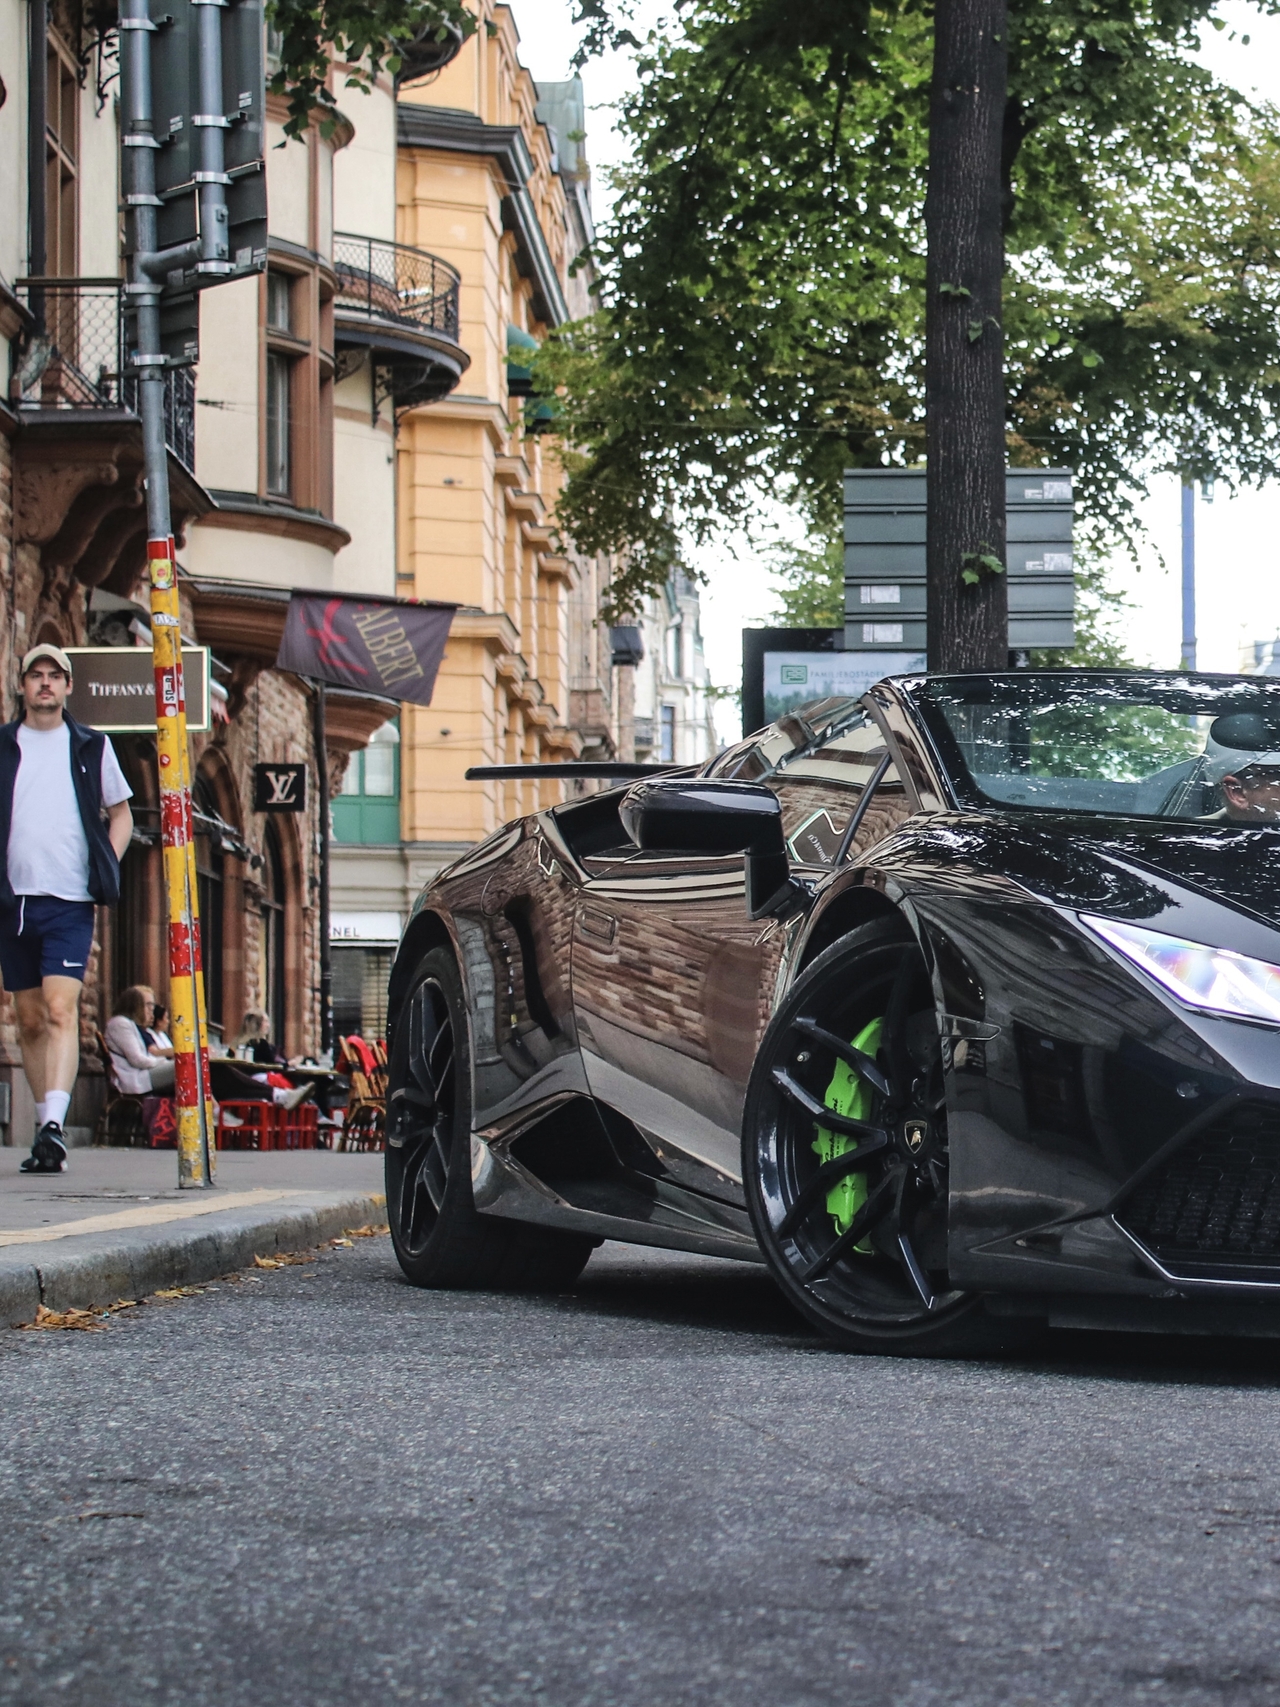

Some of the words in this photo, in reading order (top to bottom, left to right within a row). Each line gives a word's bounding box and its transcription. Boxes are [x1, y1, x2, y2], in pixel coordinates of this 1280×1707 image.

[352, 608, 424, 687] ALBERT
[88, 682, 144, 696] TIFFANY
[332, 927, 360, 938] NEL
